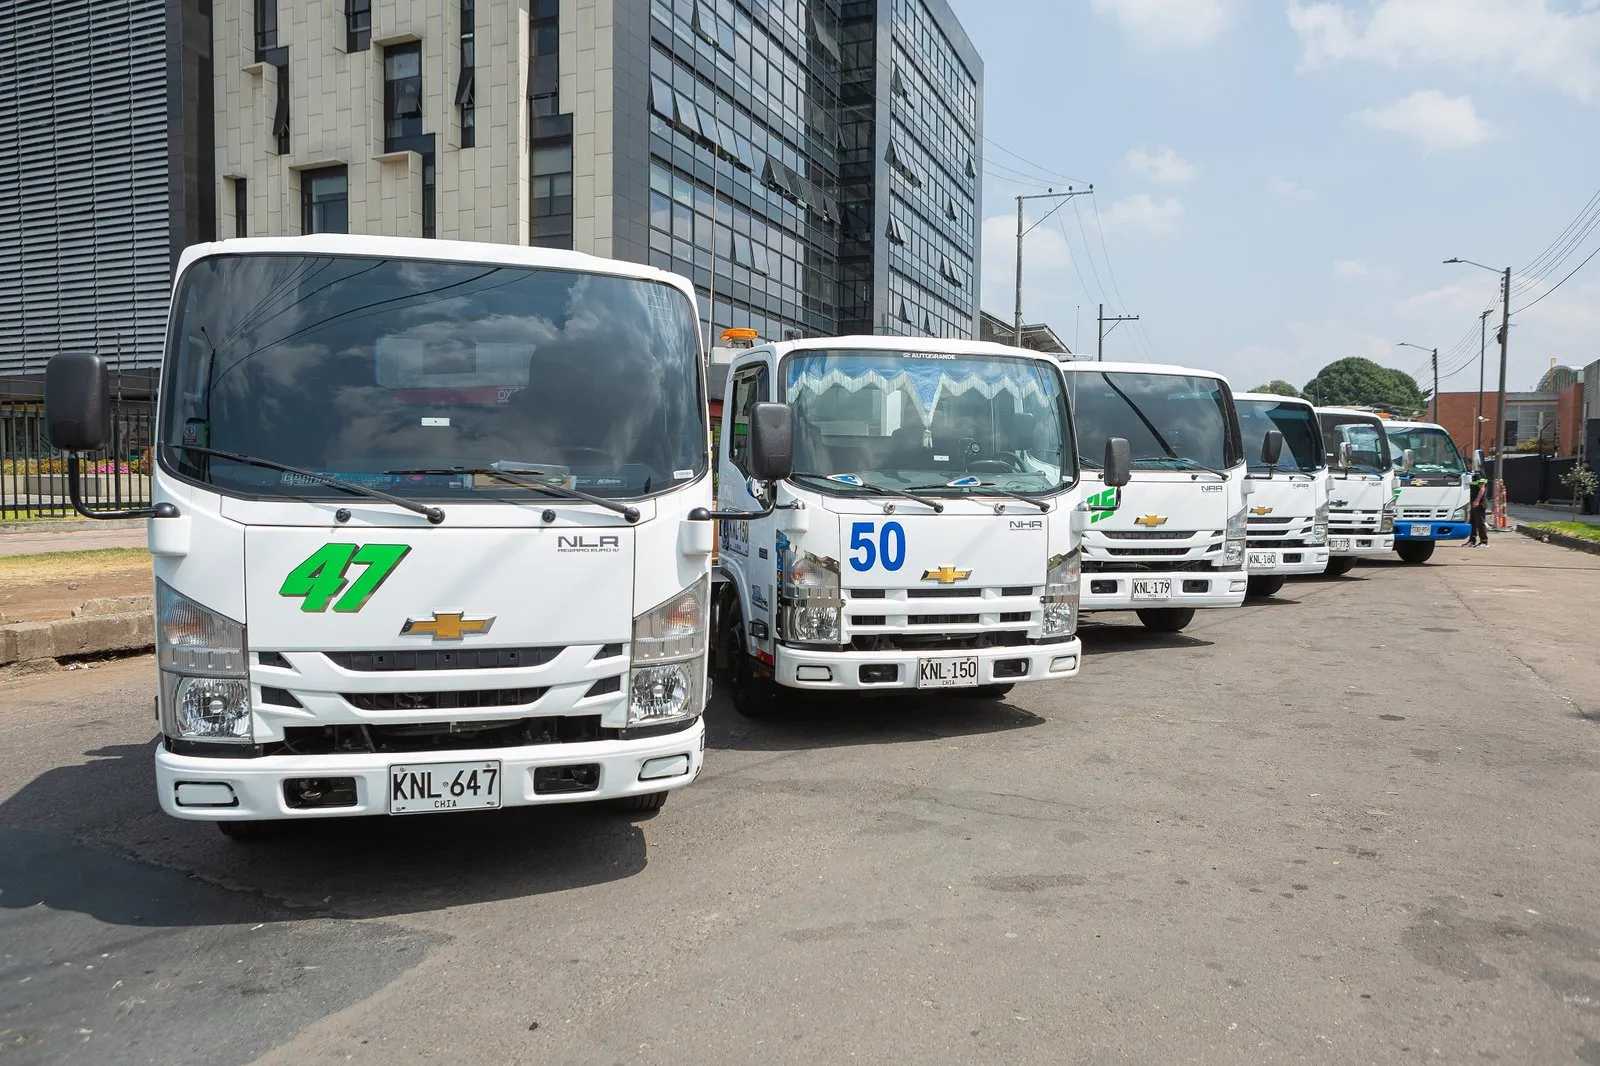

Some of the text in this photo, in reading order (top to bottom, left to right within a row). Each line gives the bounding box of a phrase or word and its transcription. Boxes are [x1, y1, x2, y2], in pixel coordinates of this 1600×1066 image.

[1009, 520, 1043, 528] NHR
[557, 536, 619, 547] NLR
[849, 521, 906, 571] 50
[279, 543, 412, 613] 47
[1153, 582, 1170, 594] 179
[921, 661, 976, 680] KNL 150
[393, 768, 498, 801] KNL 647
[434, 799, 457, 809] CHIA
